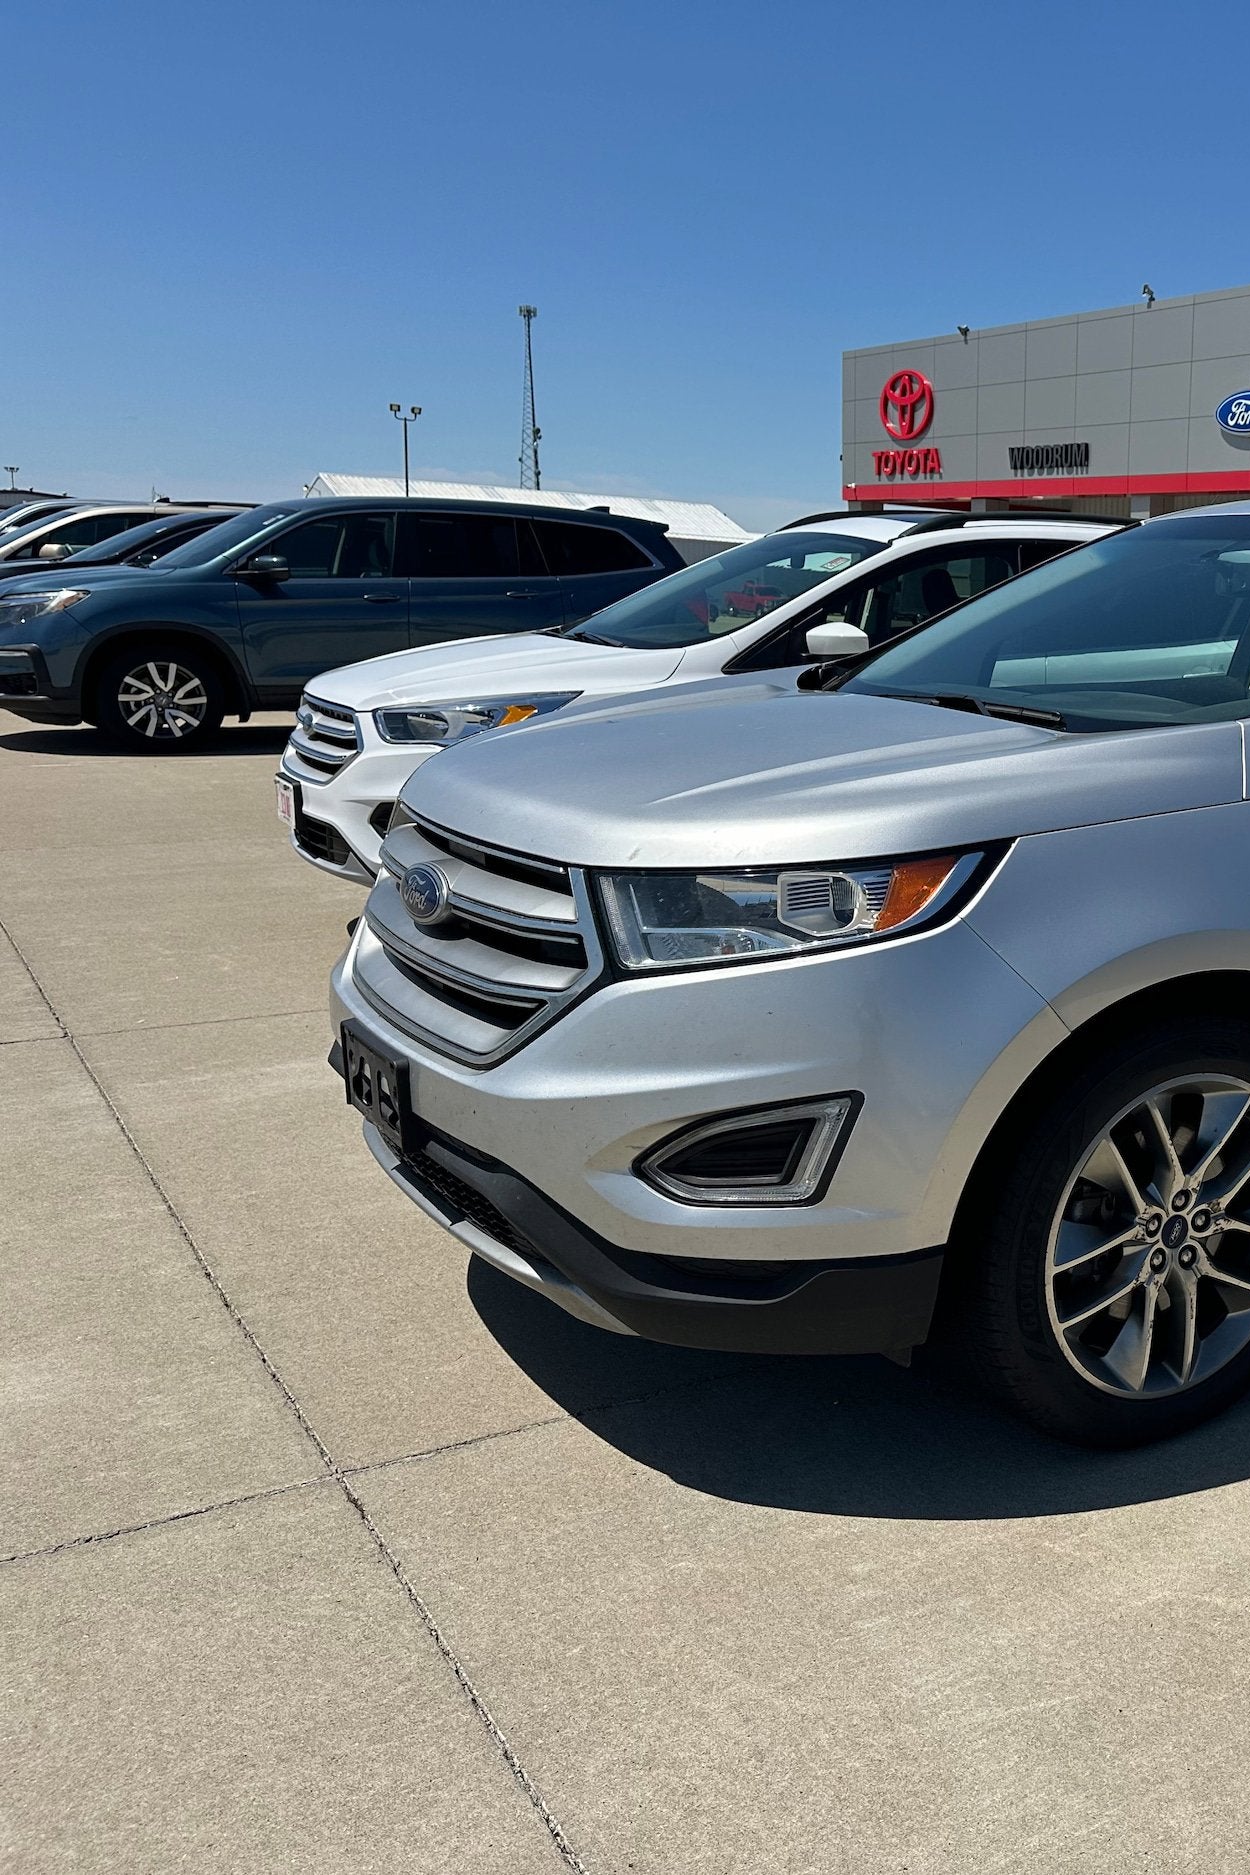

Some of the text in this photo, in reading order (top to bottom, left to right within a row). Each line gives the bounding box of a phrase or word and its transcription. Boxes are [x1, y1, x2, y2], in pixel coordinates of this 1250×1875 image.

[872, 448, 942, 476] TOYOTA
[1008, 443, 1089, 470] WOODRUM
[404, 874, 430, 910] Ford
